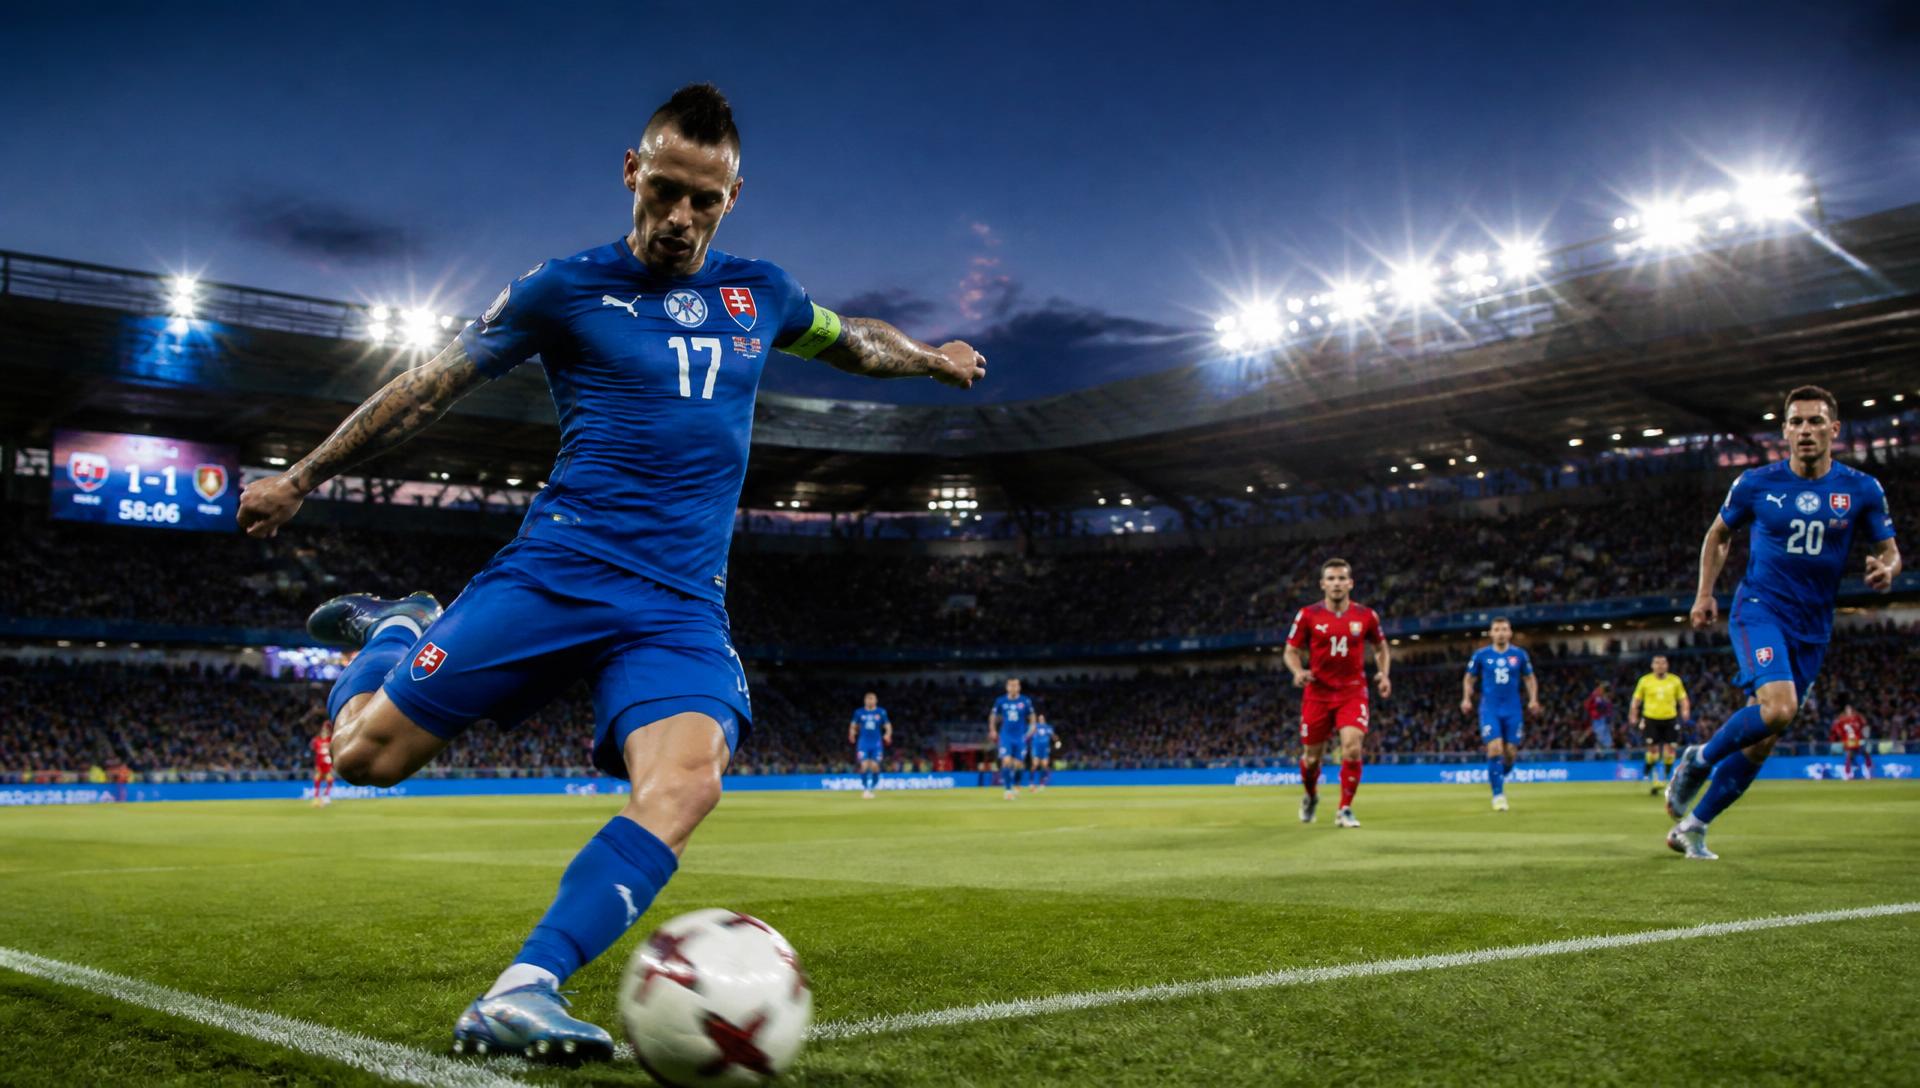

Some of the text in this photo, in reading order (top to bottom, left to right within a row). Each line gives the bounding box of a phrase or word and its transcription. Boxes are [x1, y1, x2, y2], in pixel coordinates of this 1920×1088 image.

[668, 336, 722, 400] 17
[118, 499, 181, 524] 58:06
[1787, 519, 1825, 555] 20
[1330, 635, 1349, 656] 14
